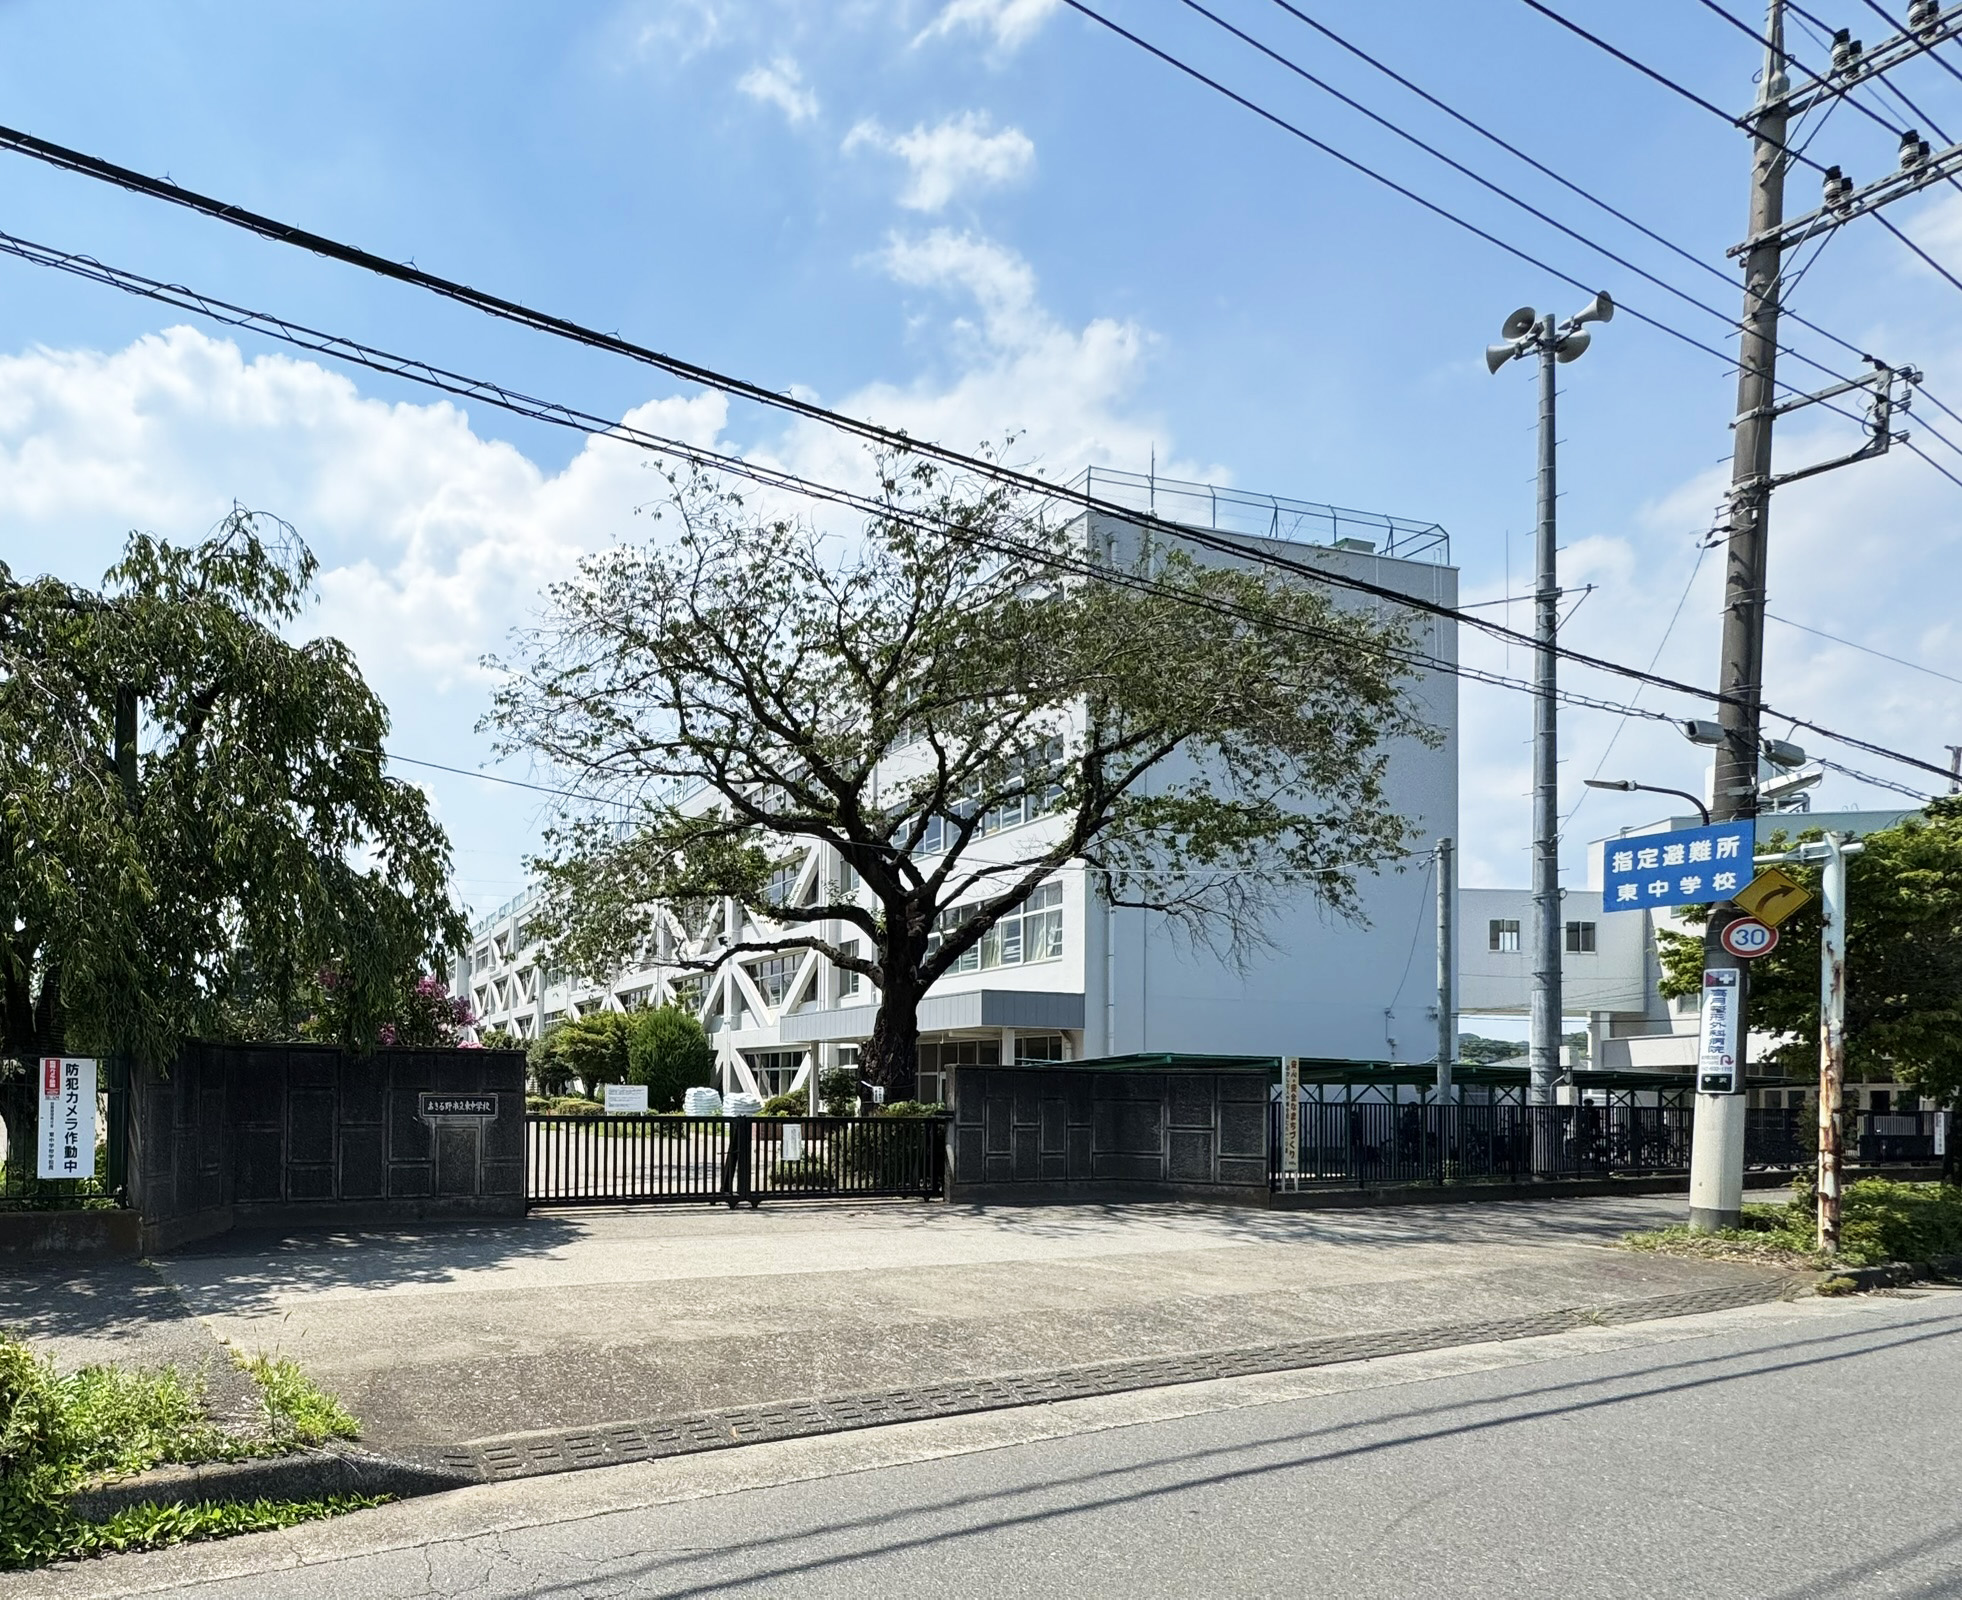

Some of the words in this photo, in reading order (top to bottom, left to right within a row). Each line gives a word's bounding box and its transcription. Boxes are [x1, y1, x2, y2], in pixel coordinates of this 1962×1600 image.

[1612, 836, 1740, 874] 指定避難所
[1616, 872, 1737, 902] 東中学校
[1735, 929, 1765, 946] 30
[64, 1063, 79, 1173] 防犯カメラ作動中
